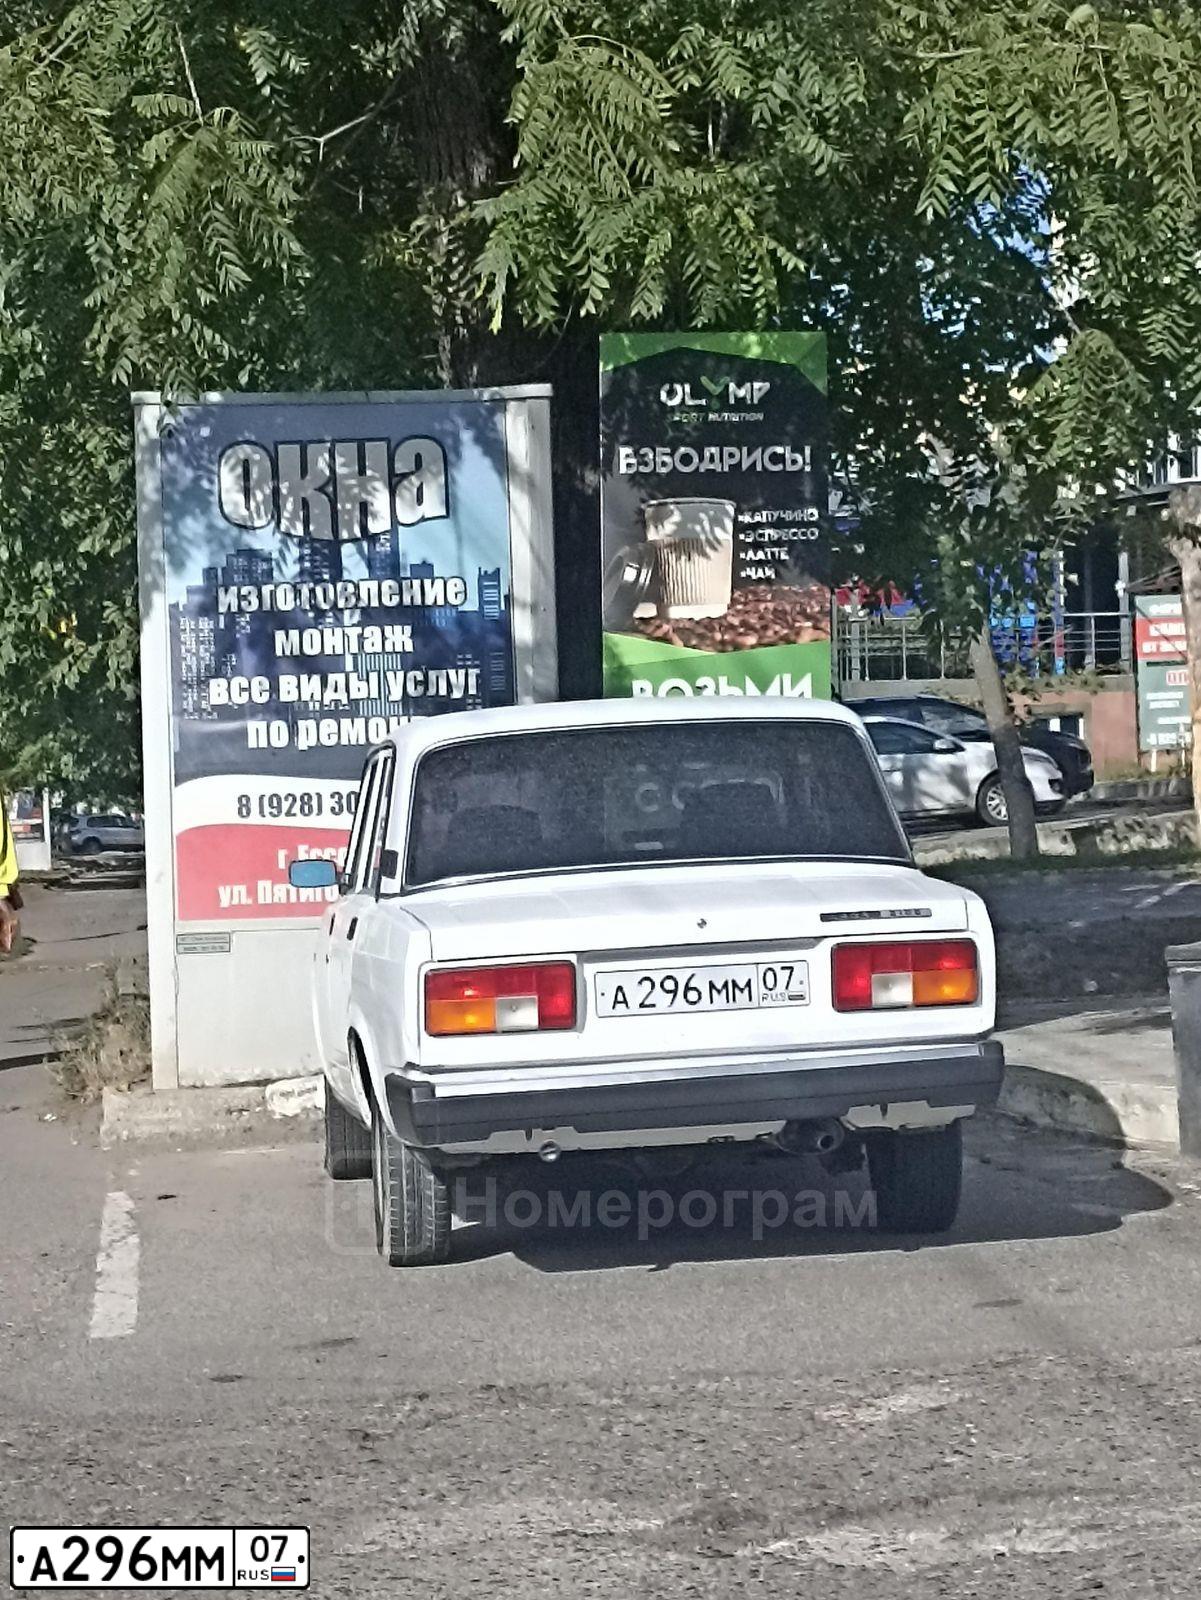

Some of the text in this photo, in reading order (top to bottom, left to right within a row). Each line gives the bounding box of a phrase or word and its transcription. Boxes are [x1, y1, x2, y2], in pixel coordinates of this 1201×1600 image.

[618, 445, 812, 476] ВЗБОДРИСЬ!
[217, 576, 467, 614] изготовление
[275, 624, 413, 657] монтаж
[209, 667, 481, 705] все виды услуг
[248, 719, 290, 749] по
[237, 794, 251, 819] 8
[258, 792, 322, 817] (928)
[218, 885, 253, 908] ул.
[611, 965, 795, 1011] А296ММ 07
[761, 992, 787, 1003] RUS
